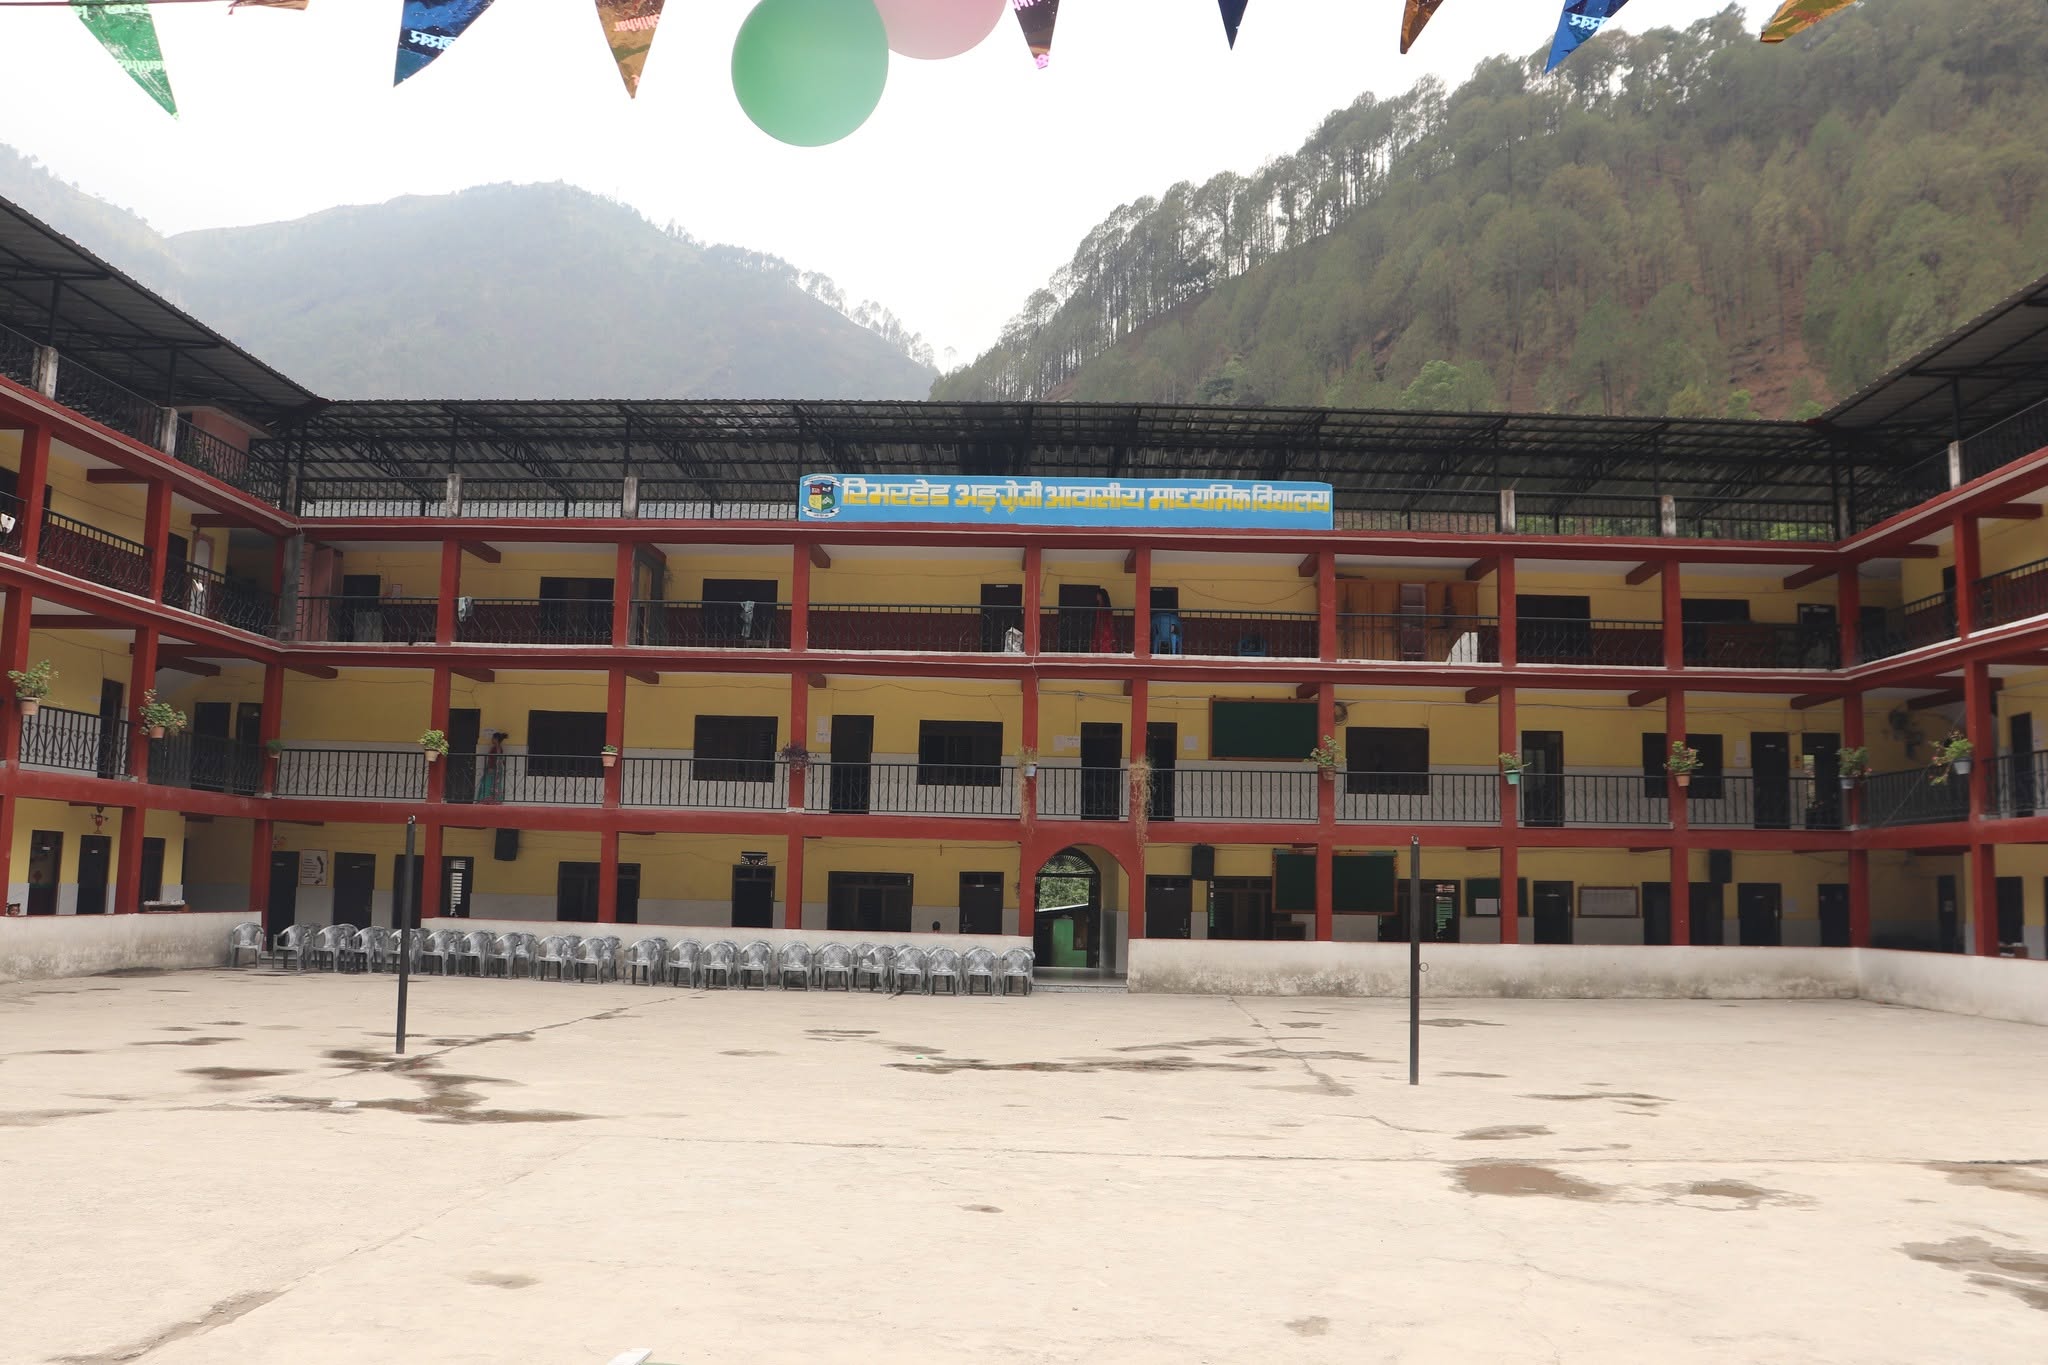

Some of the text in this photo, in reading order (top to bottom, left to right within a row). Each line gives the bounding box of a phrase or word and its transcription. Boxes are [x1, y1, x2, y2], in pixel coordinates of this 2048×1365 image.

[1045, 482, 1146, 509] आवासीय
[1147, 484, 1251, 512] माध्यमिक
[1251, 484, 1332, 513] विद्यालय
